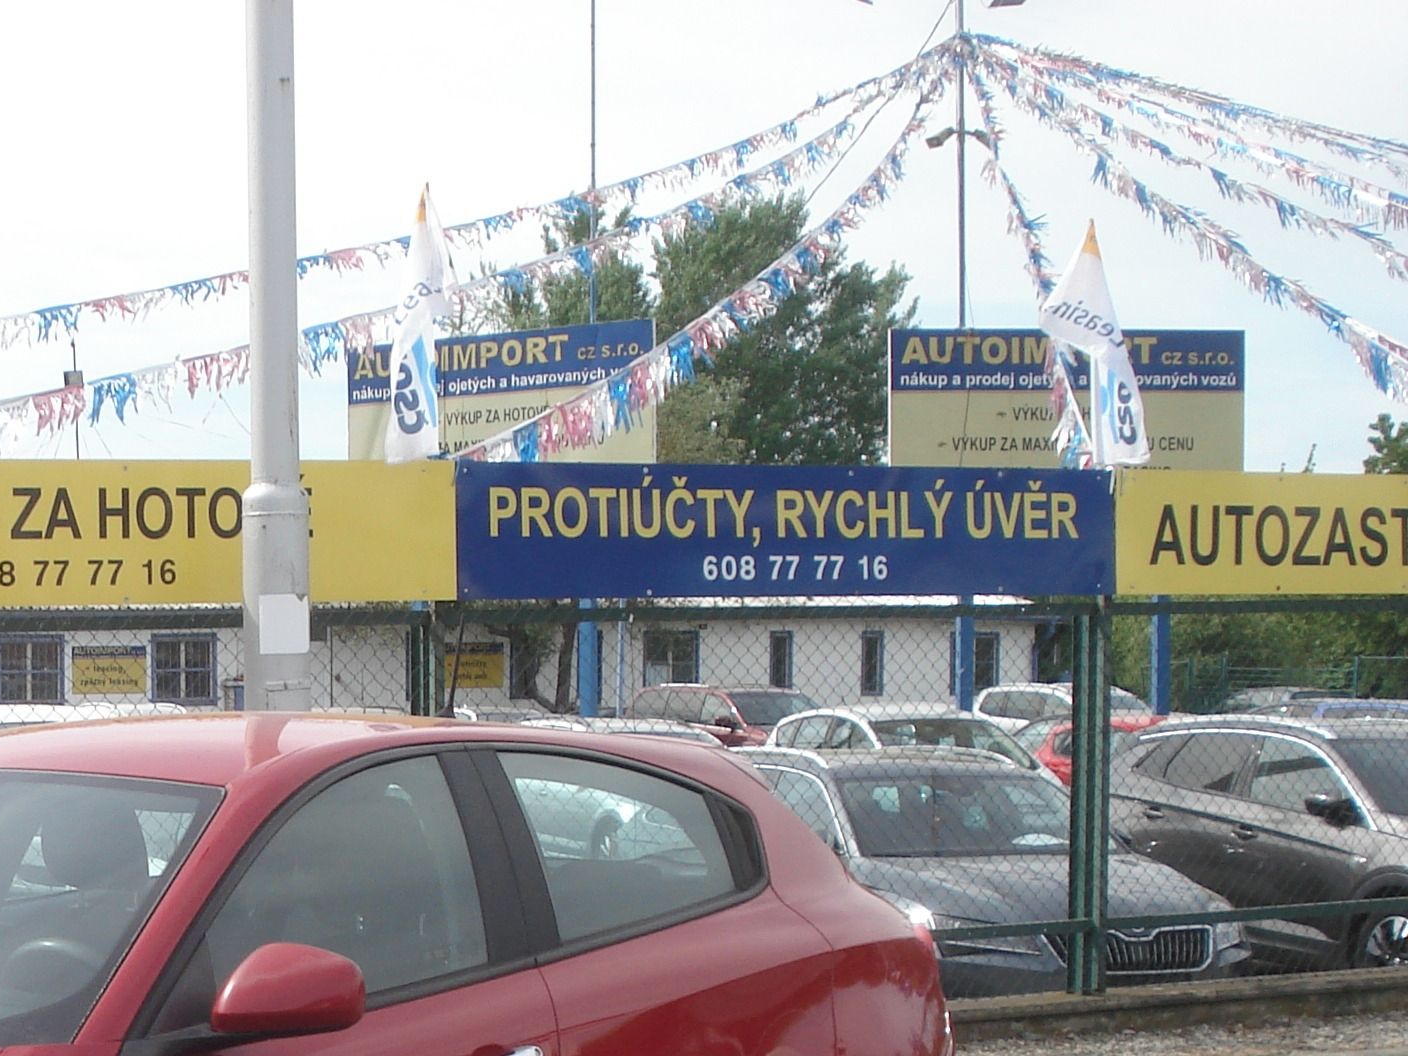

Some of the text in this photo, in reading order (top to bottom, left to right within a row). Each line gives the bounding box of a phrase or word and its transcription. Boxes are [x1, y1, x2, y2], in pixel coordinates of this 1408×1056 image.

[354, 334, 644, 380] AUIMPORT cz s.r.o.
[901, 336, 1235, 366] AUTOIMT cz s.r.o.
[352, 384, 391, 401] nákup
[449, 376, 496, 395] ojetých
[499, 377, 508, 387] a
[511, 366, 606, 387] havarovaných
[899, 371, 948, 388] nákup
[952, 375, 962, 386] a
[966, 371, 1015, 388] prodej
[1078, 375, 1088, 386] a
[1135, 370, 1198, 388] ovaných
[1202, 370, 1237, 386] vozů
[446, 409, 483, 426] VÝKUP
[486, 410, 501, 423] ZA
[1012, 404, 1054, 421] VÝKU
[952, 434, 997, 452] VÝKUP
[1001, 437, 1018, 451] ZA
[1159, 436, 1194, 451] CENU
[10, 487, 83, 540] ZA
[98, 473, 314, 540] HOTO
[488, 475, 1080, 548] PROTIÚČTY, RYCHLÝ ÚVĚR
[33, 560, 70, 587] 77
[87, 559, 124, 587] 77
[142, 559, 178, 586] 16
[702, 554, 889, 582] 608 77 77 16
